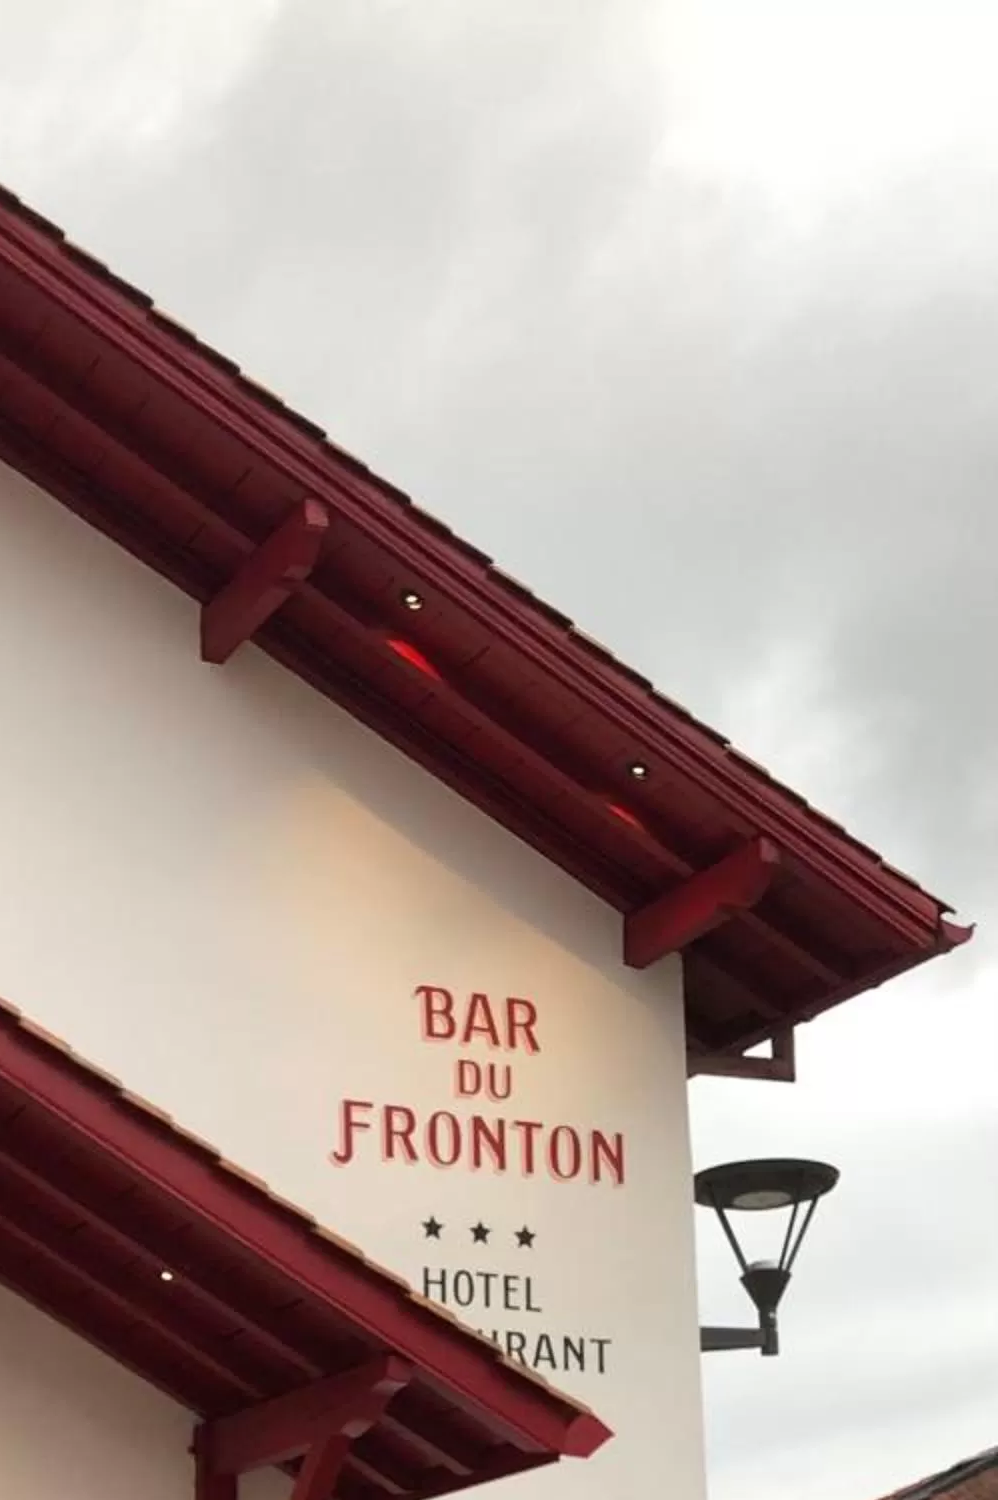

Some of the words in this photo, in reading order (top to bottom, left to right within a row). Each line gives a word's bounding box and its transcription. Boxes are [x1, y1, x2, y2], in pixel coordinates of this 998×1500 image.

[413, 984, 542, 1054] BAR
[455, 1058, 513, 1101] DU
[329, 1099, 626, 1187] FRONTON
[422, 1266, 543, 1313] HOTEL
